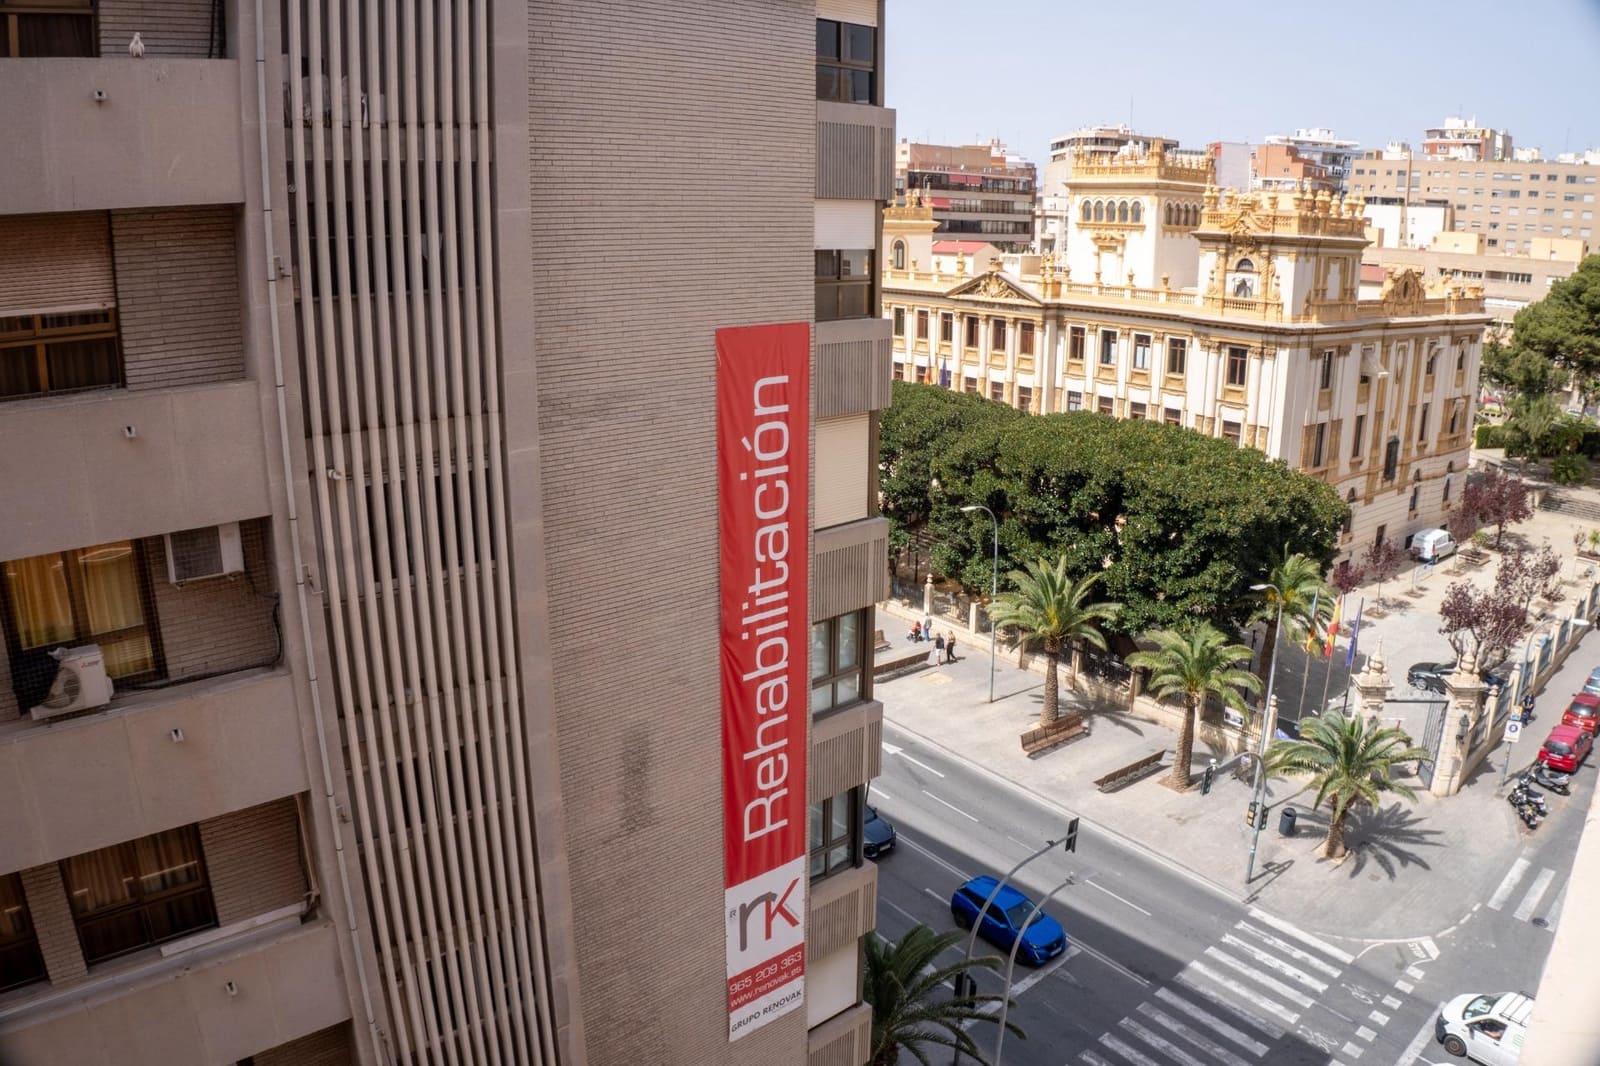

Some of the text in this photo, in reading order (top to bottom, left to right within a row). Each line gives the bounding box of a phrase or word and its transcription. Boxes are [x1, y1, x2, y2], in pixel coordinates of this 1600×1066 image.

[740, 375, 790, 841] Rehabilitación
[729, 951, 802, 995] 965 209 363
[731, 989, 803, 1032] GRUPO RENOVAK
